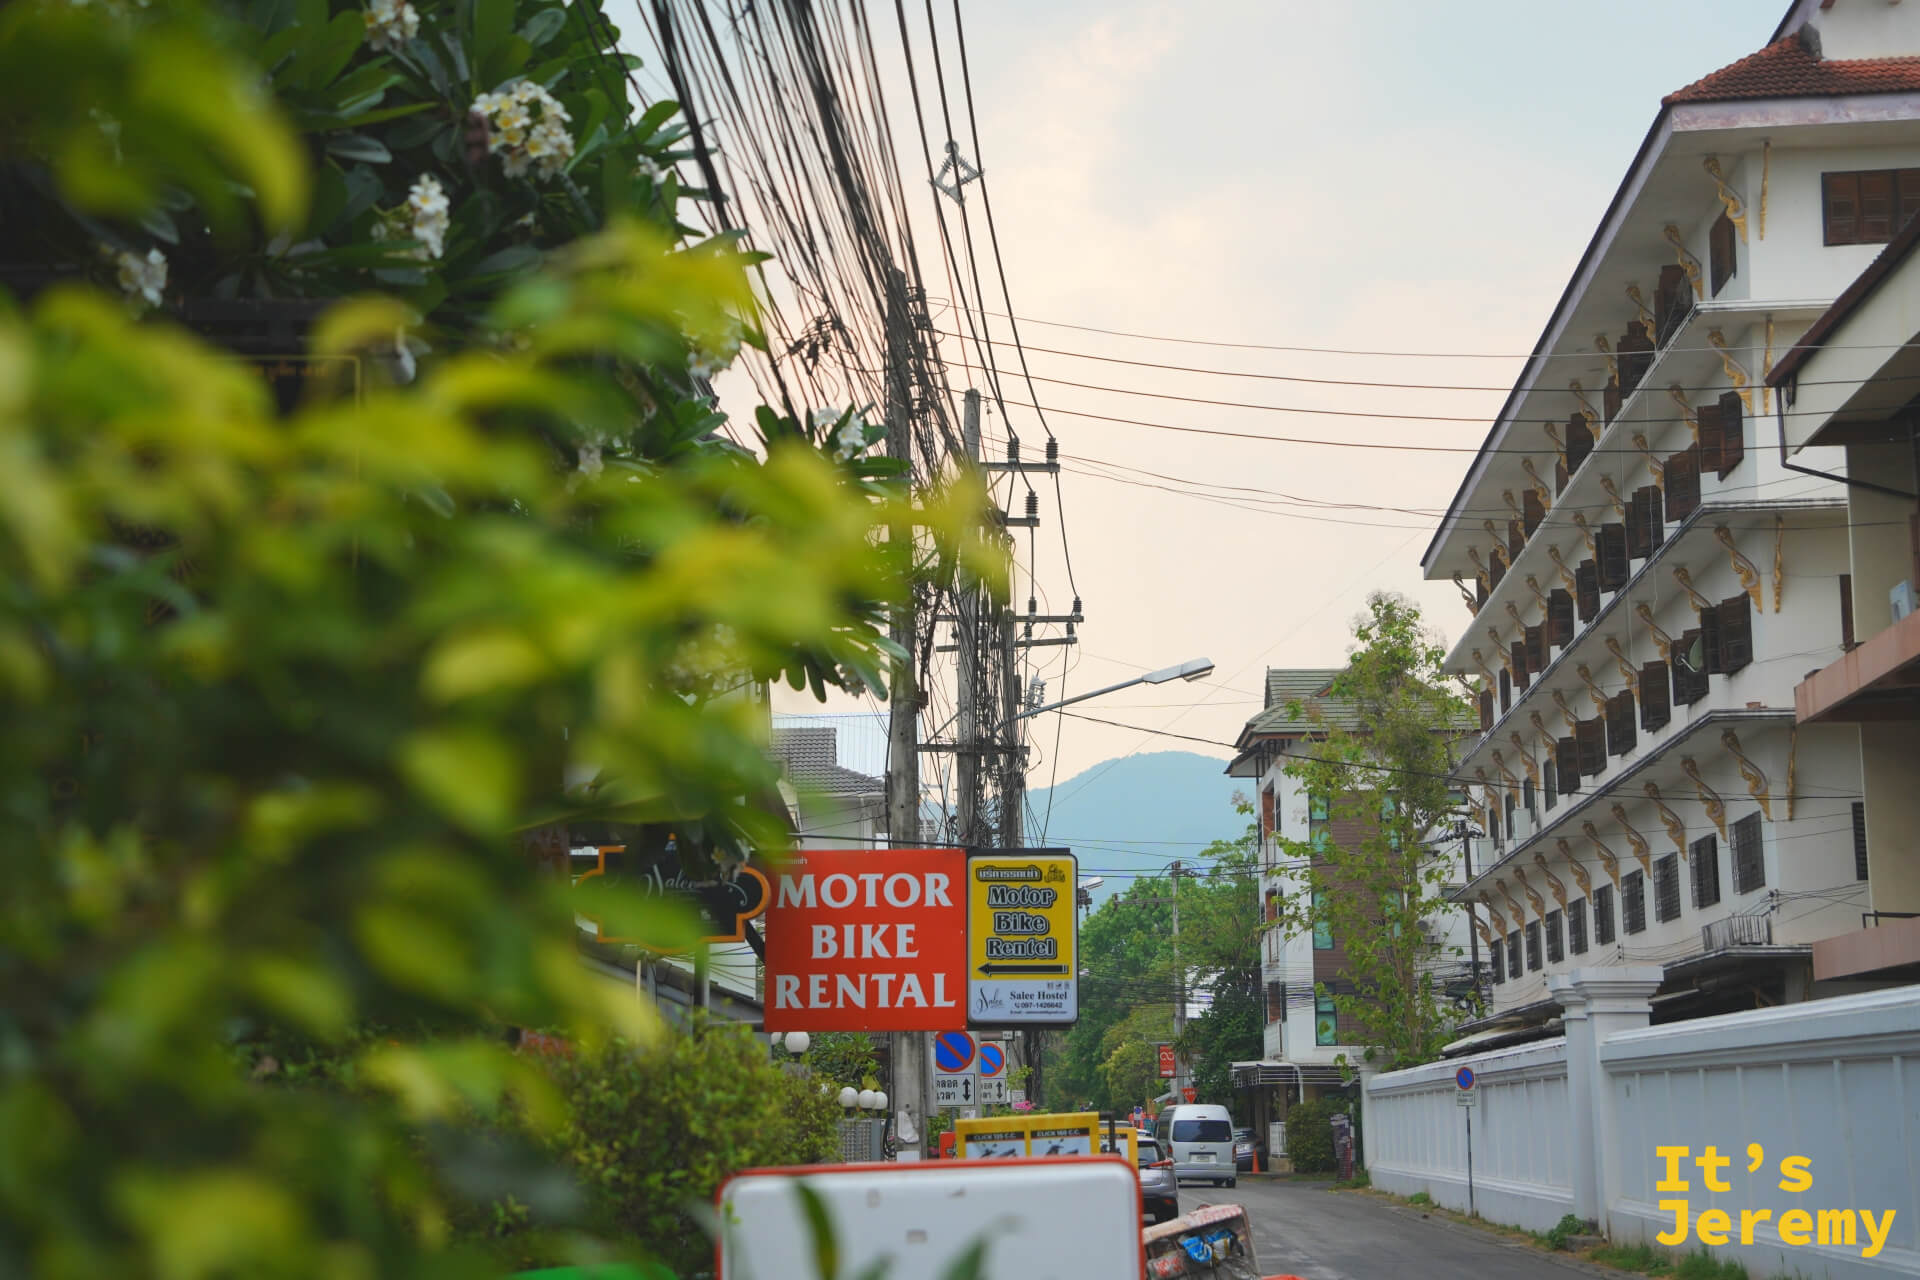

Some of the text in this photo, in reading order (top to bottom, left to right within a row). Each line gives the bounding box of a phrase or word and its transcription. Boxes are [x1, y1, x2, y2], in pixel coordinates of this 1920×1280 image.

[776, 873, 954, 908] MOTOR
[988, 885, 1056, 906] Motor
[994, 913, 1049, 933] Bike
[811, 924, 919, 959] BIKE
[775, 973, 956, 1009] RENTAL
[1009, 991, 1067, 1000] Salee Hostel
